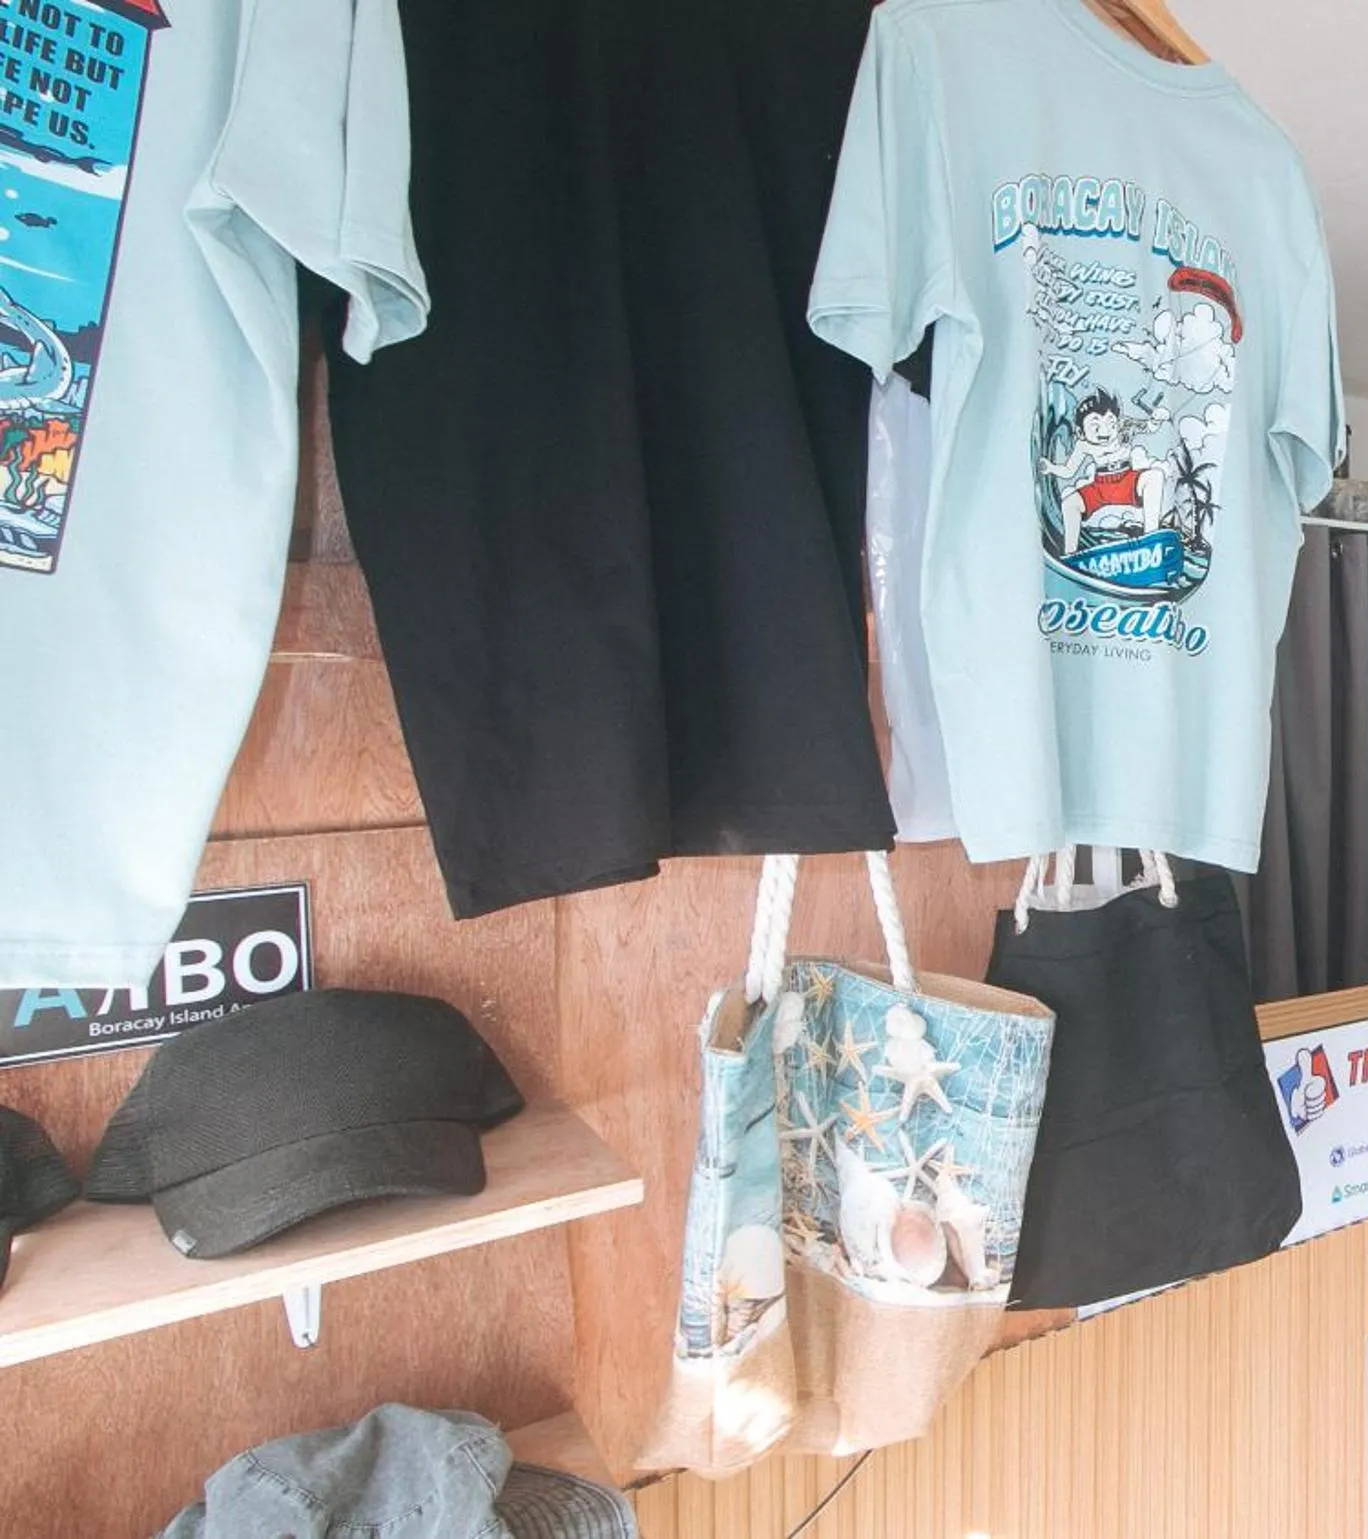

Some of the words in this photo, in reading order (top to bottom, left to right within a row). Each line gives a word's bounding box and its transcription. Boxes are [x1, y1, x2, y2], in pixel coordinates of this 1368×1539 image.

[18, 0, 81, 38] NOT
[89, 22, 125, 56] TO
[65, 48, 125, 90] BUT
[29, 67, 92, 112] NOT
[49, 110, 95, 150] US.
[1069, 260, 1137, 288] WINGS
[1104, 646, 1152, 662] LIVING
[89, 1015, 165, 1037] Boracay
[170, 1004, 225, 1026] Island
